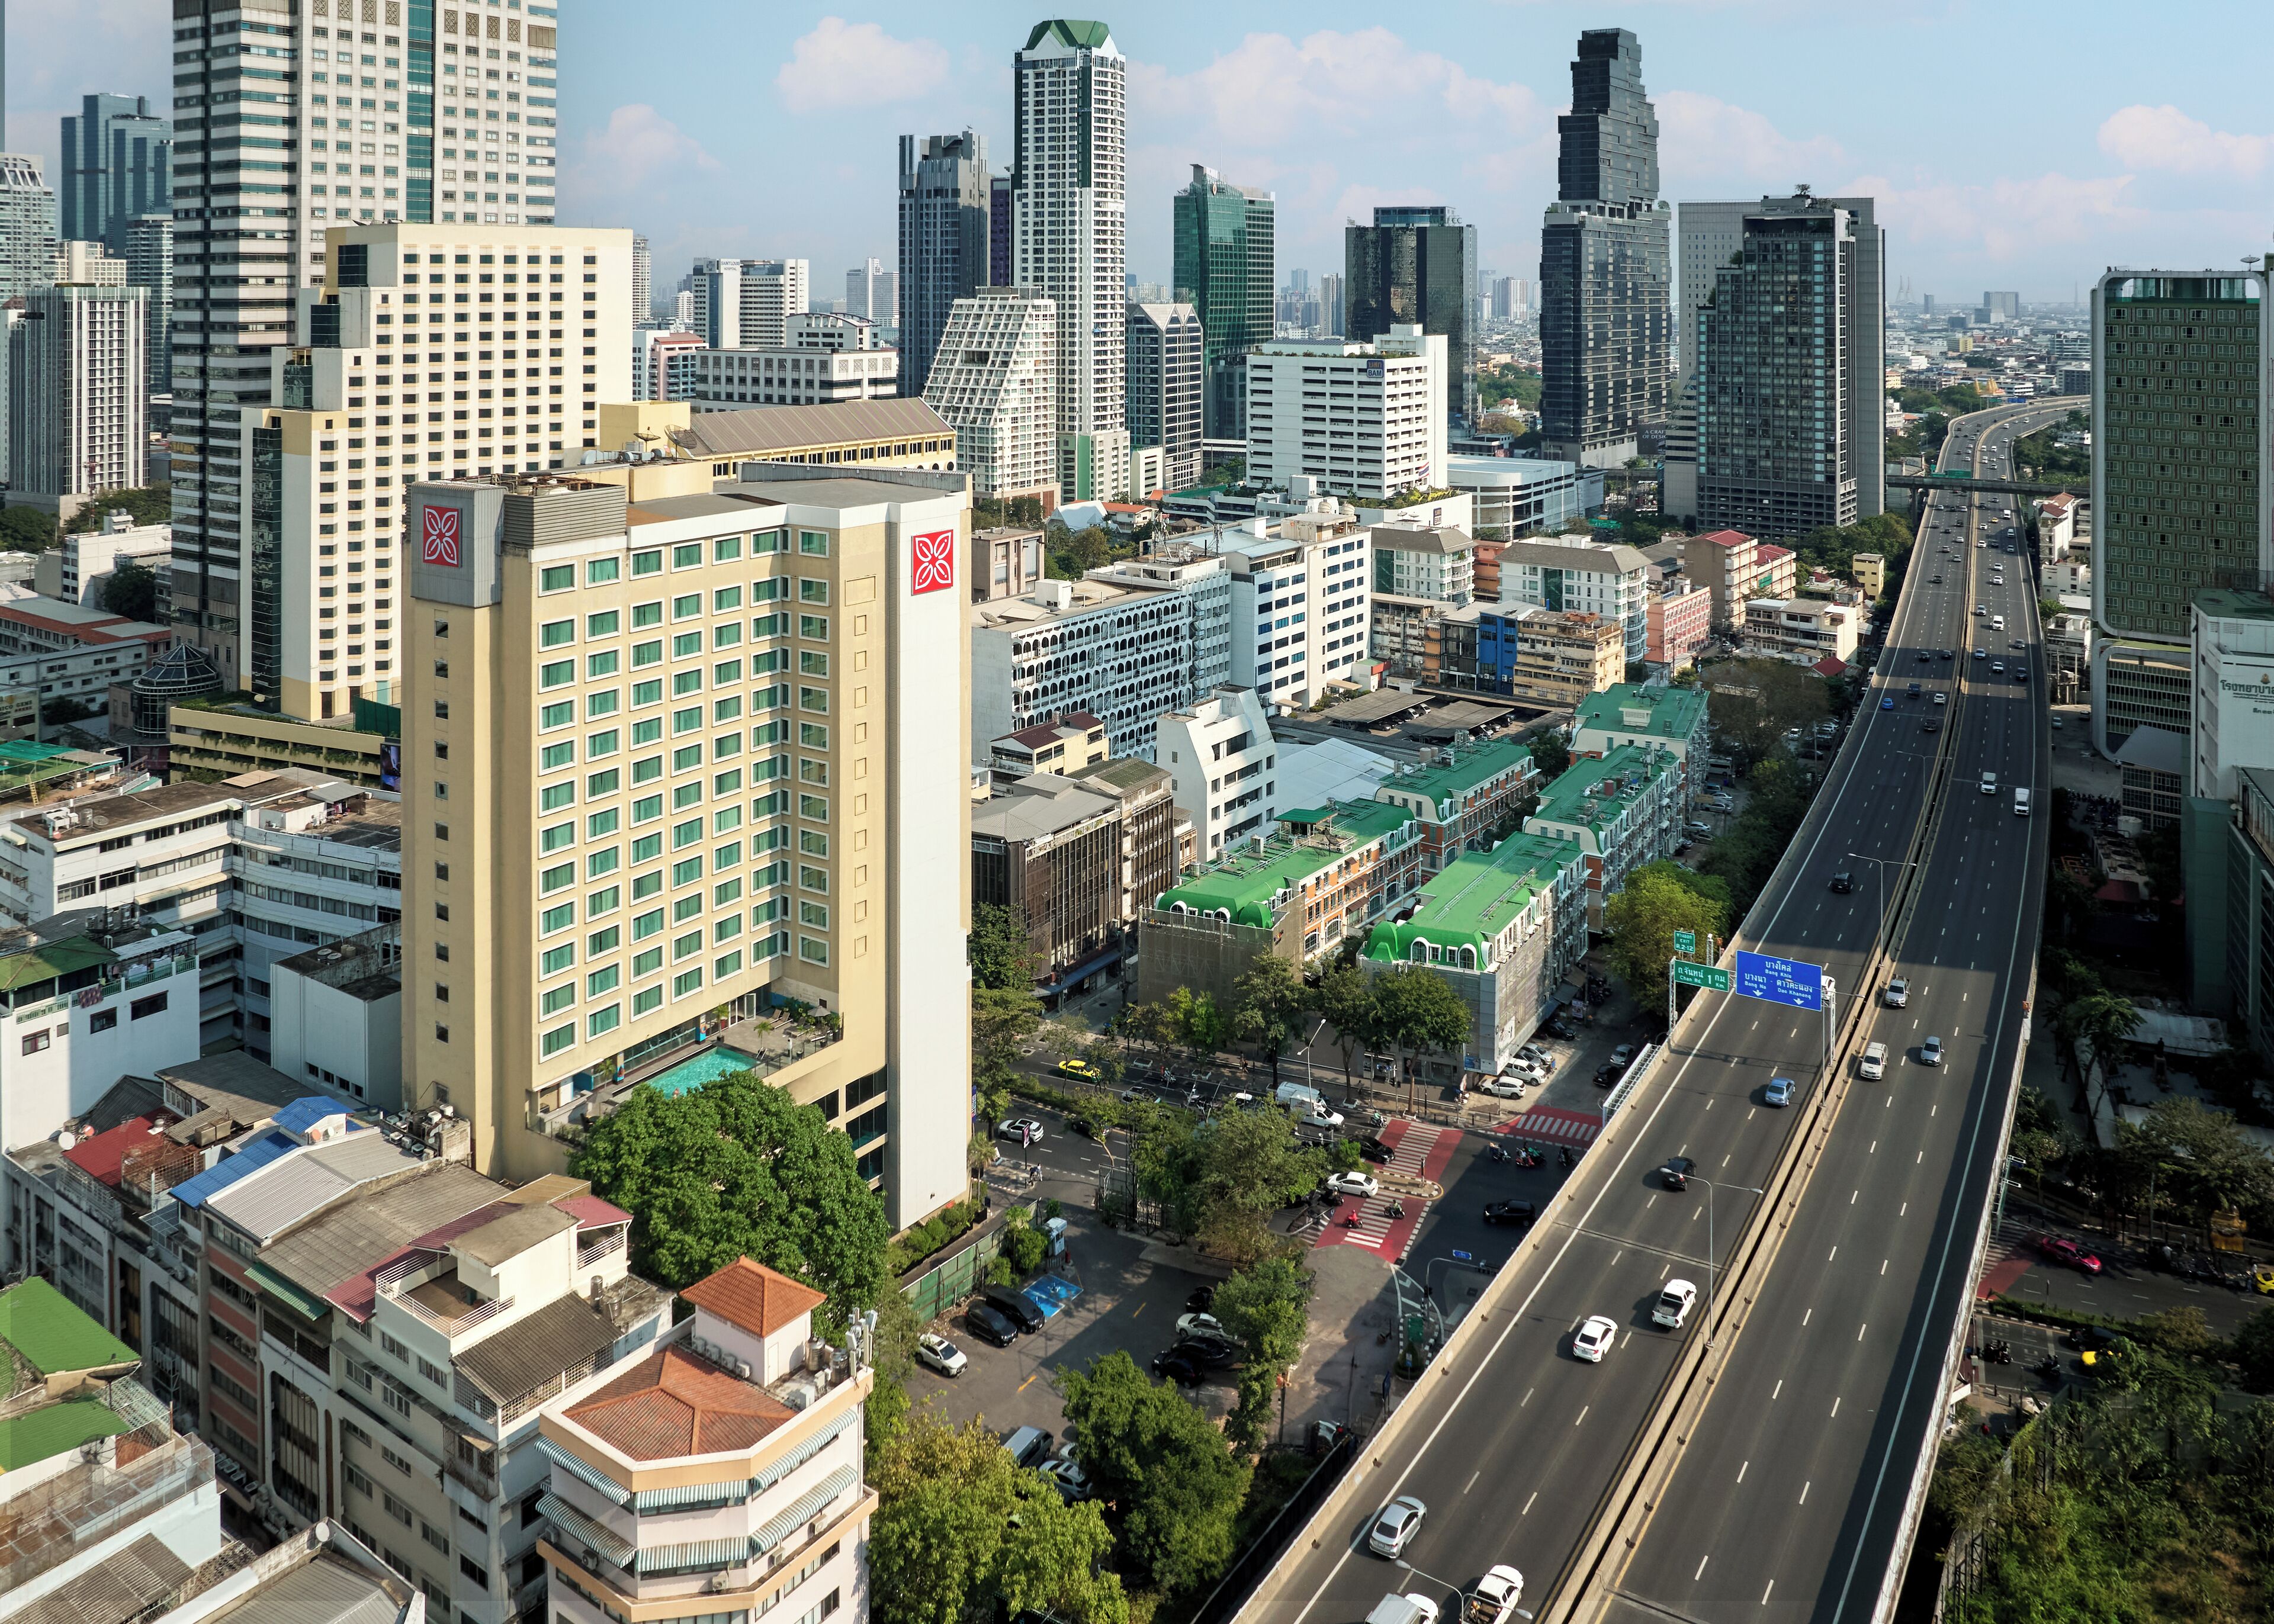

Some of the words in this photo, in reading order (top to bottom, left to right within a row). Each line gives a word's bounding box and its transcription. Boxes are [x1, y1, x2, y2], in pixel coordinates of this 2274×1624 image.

[1765, 960, 1791, 972] บางโคล่
[1745, 973, 1766, 983] บางนา
[1765, 969, 1778, 977] Bang
[1707, 975, 1711, 985] 1
[1745, 980, 1758, 989] Bang
[1789, 990, 1812, 1000] Khanong
